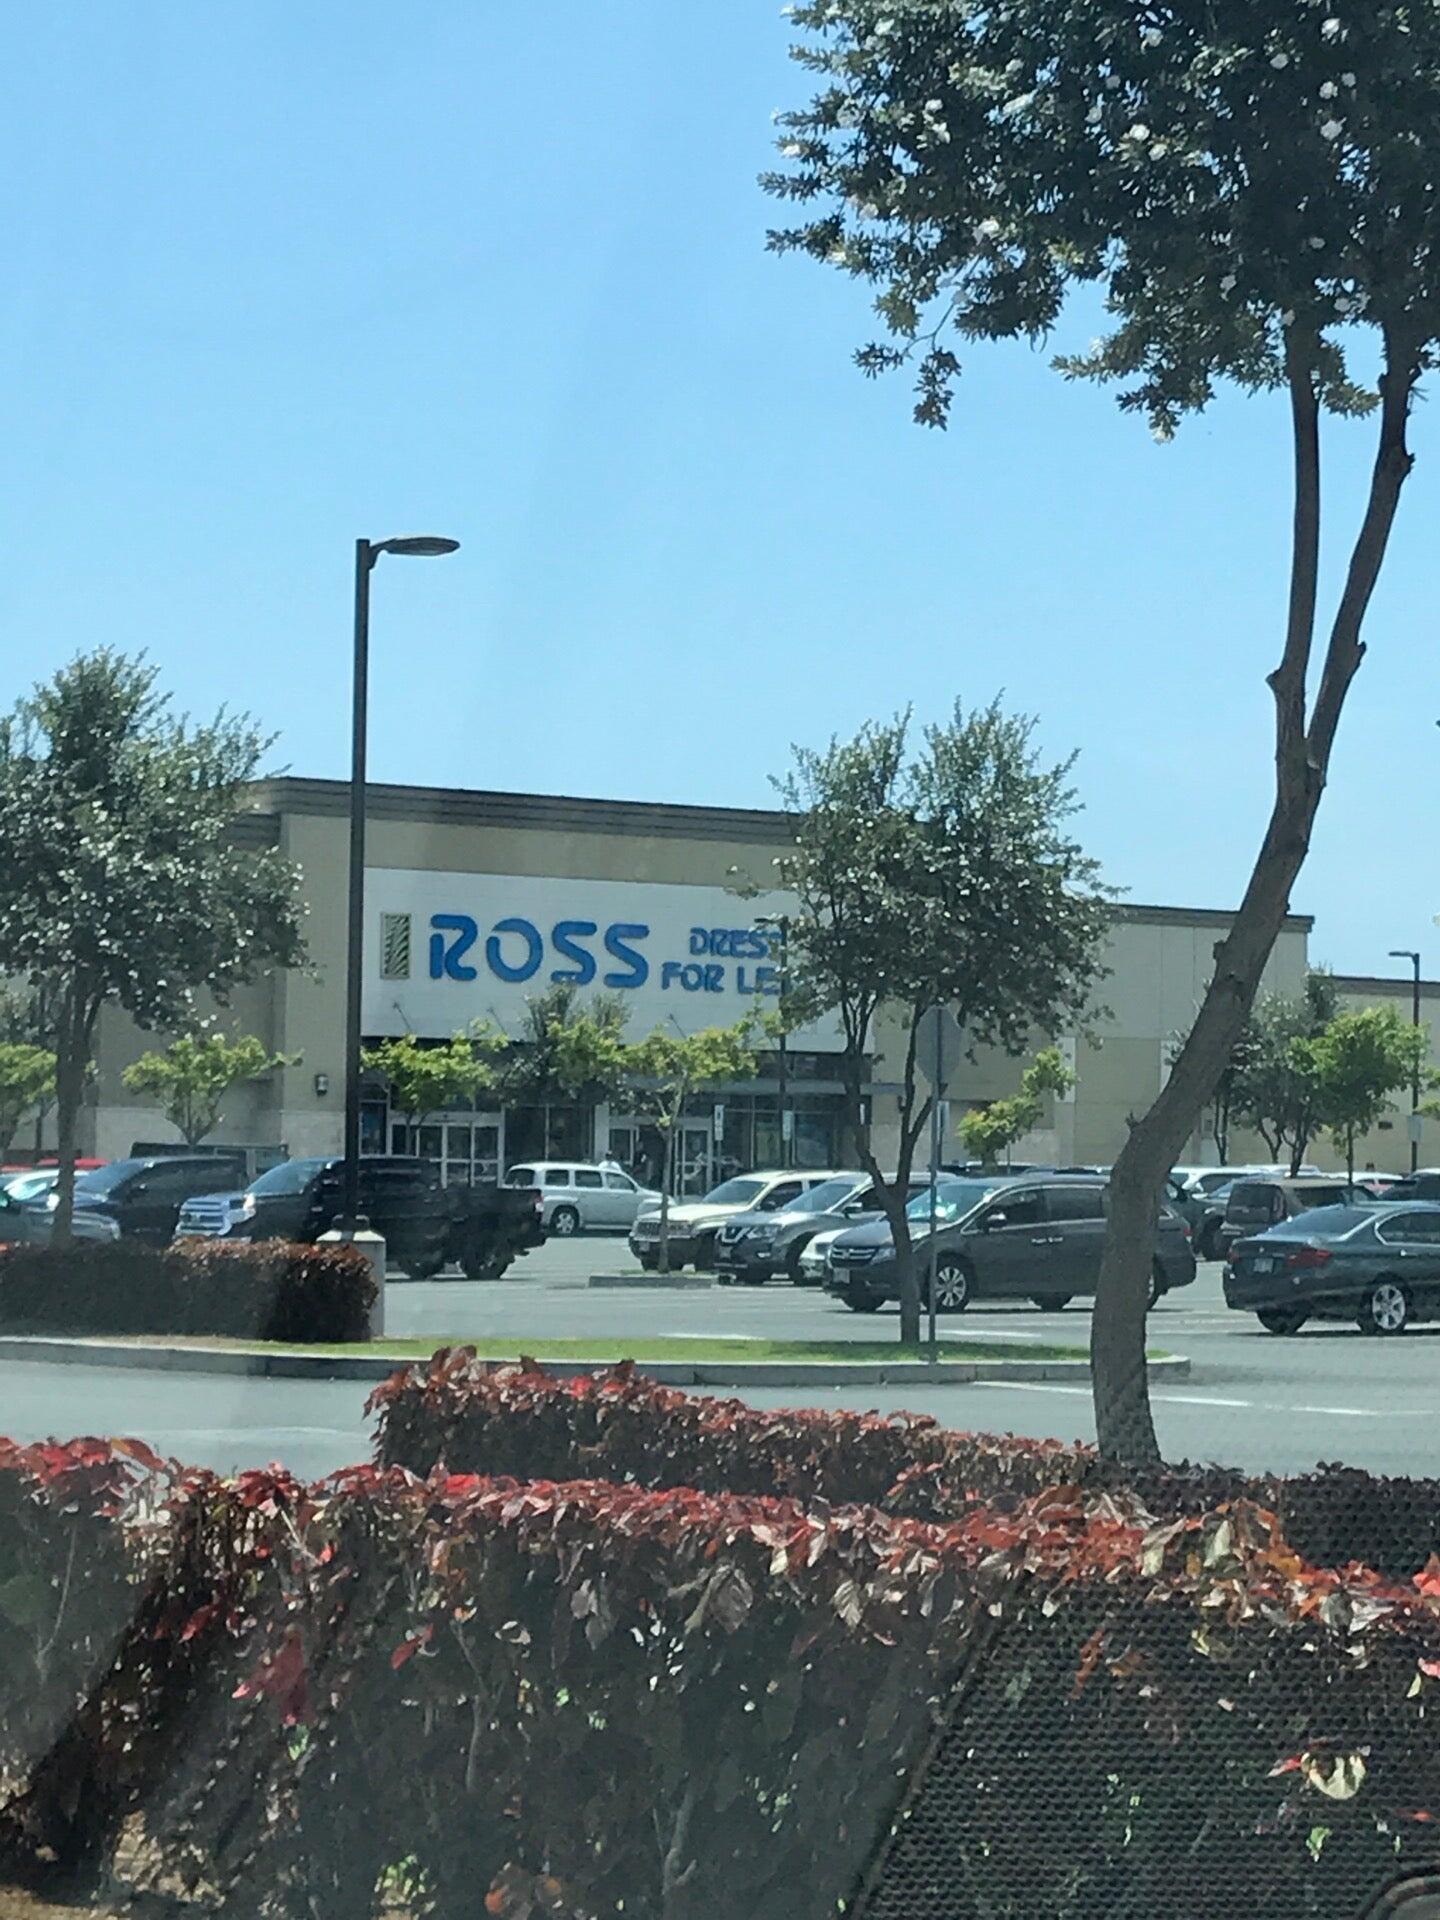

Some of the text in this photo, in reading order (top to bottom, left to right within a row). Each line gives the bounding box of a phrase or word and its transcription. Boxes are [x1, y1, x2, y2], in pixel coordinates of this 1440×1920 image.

[429, 913, 651, 989] ROSS
[661, 962, 780, 995] FOR LE
